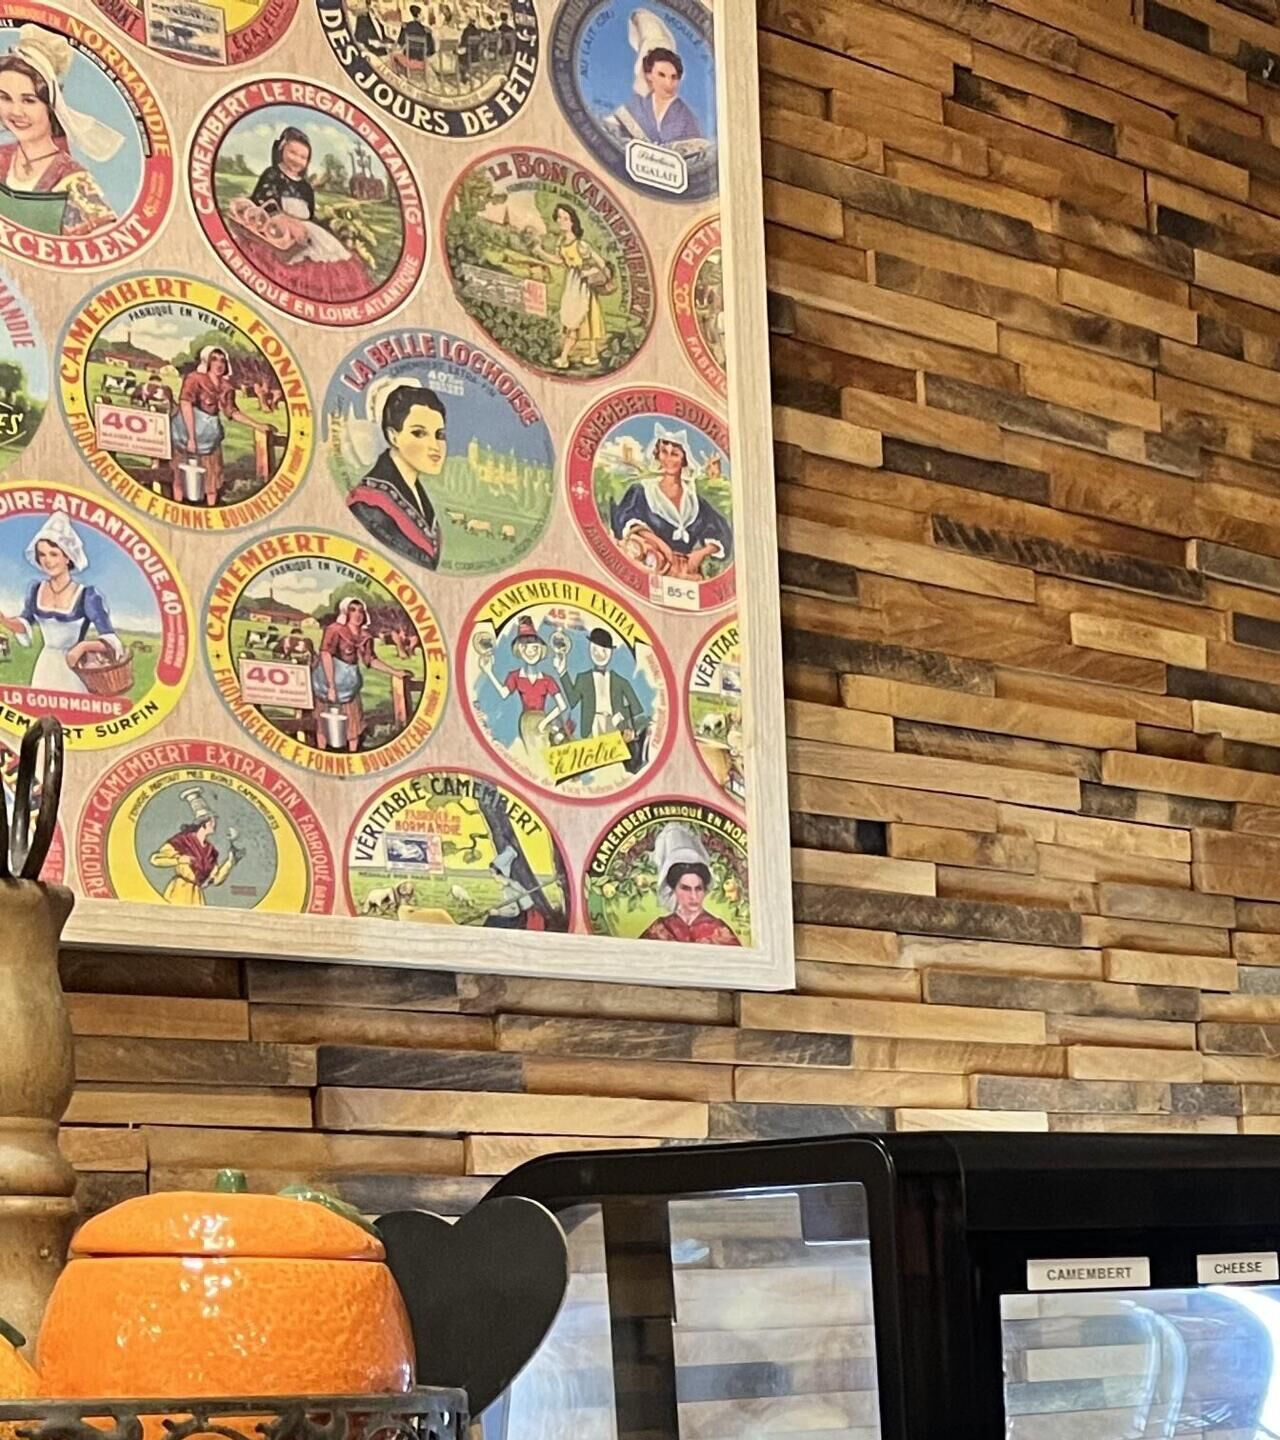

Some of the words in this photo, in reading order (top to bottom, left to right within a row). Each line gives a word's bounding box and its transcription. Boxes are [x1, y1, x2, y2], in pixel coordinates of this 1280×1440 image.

[66, 17, 171, 157] NORMANDIE
[320, 8, 359, 66] DES
[355, 71, 449, 134] JOURS
[461, 106, 498, 135] DE
[193, 90, 249, 214] CAMEMBERT
[488, 160, 513, 182] LE
[511, 153, 569, 185] BON
[179, 306, 193, 316] EN
[295, 302, 315, 317] EN
[319, 253, 420, 321] LOIRE-ATLANTIQUE
[60, 277, 193, 385] CAMEMBERT
[340, 358, 377, 392] LA
[365, 332, 435, 369] BELLE
[440, 335, 541, 428] LOCHOISE
[575, 393, 658, 462] CAMEMBERT
[69, 412, 145, 506] FROMAGERIE
[219, 473, 296, 529] BOURNEZEAU
[206, 533, 331, 643] CAMEMBERT
[317, 560, 331, 571] EN
[489, 582, 581, 618] CAMEMBERT
[590, 593, 637, 638] EXTRA
[4, 690, 23, 705] LA
[27, 695, 123, 716] GOURMANDE
[96, 700, 160, 738] SURFIN
[213, 667, 288, 756] FROMAGERIE
[362, 717, 433, 773] BOURNEZEAU
[92, 744, 193, 813] CAMEMBERT
[206, 745, 269, 784] EXTRA
[354, 781, 427, 862] VÉRITABLE
[430, 777, 543, 837] CAMEMBERT
[592, 806, 654, 873] CAMEMBERT
[707, 814, 722, 829] EN
[1046, 1265, 1134, 1283] CAMEMBERT
[1214, 1261, 1263, 1276] CHEESE
